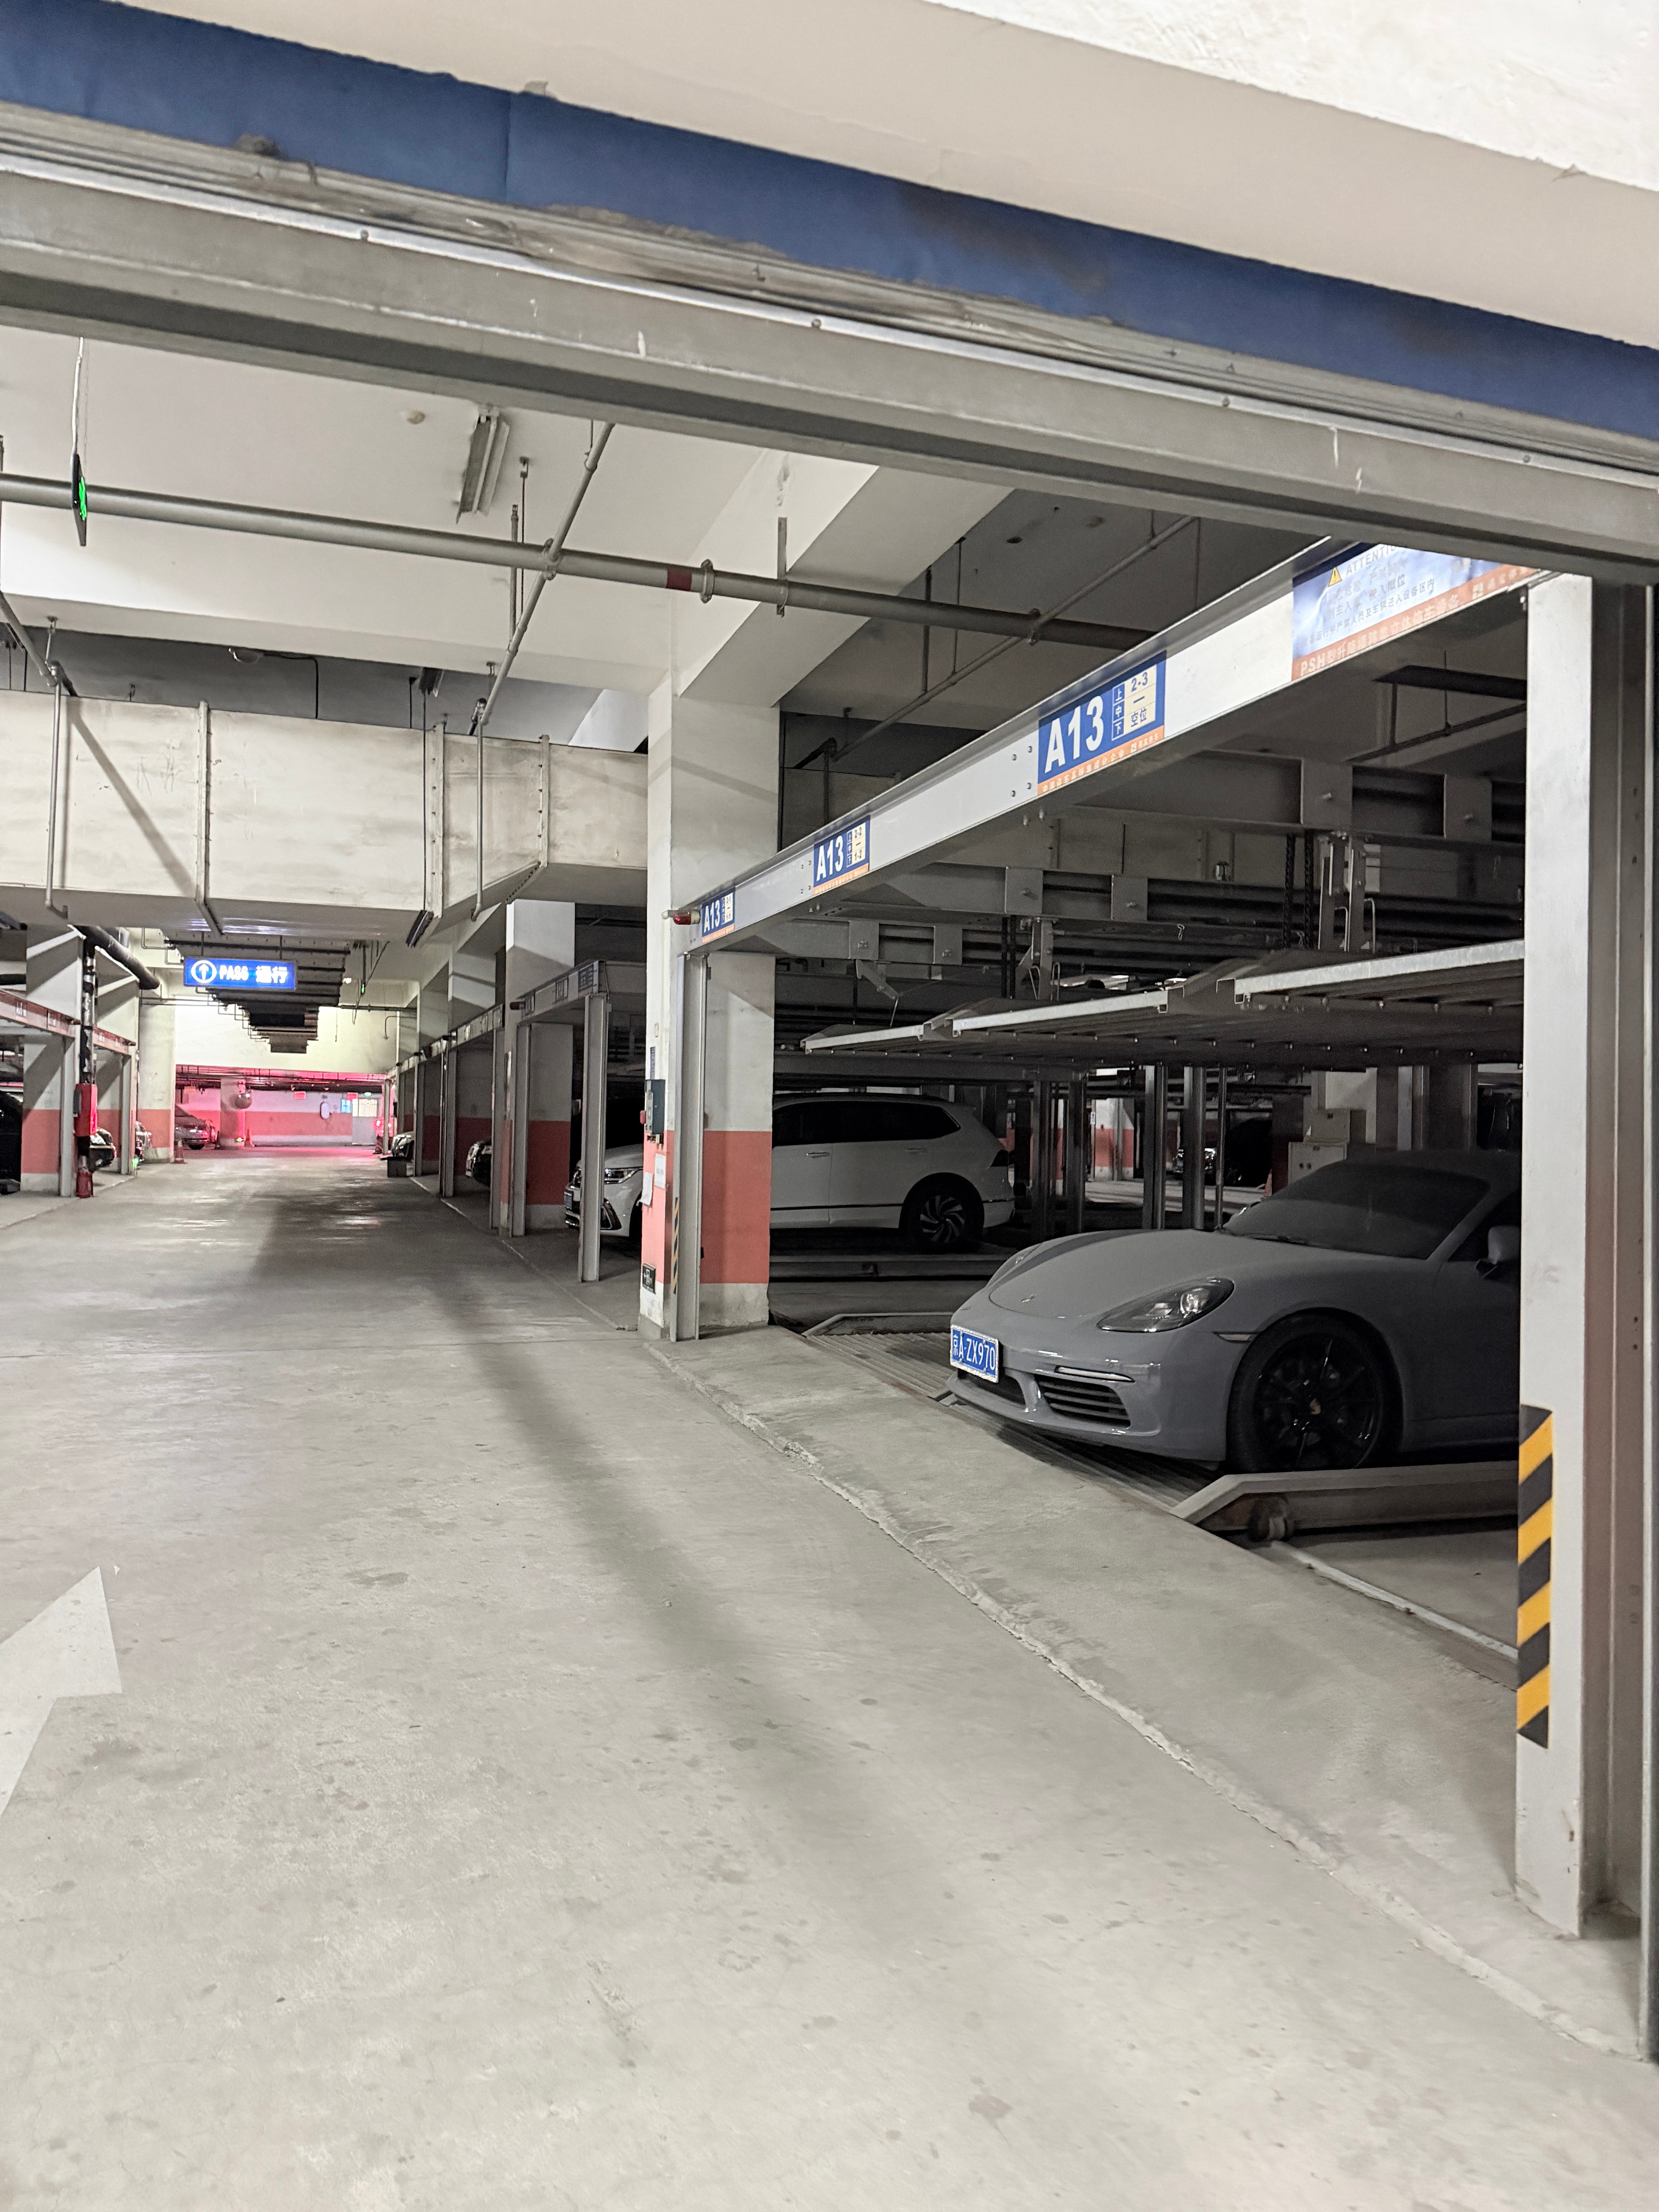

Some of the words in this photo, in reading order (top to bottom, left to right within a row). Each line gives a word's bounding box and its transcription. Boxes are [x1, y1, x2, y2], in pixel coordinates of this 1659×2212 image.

[1115, 688, 1122, 702] 上
[1115, 705, 1122, 718] 中
[1131, 707, 1147, 727] 空位
[1044, 696, 1104, 774] A13
[1115, 721, 1122, 735] 下
[816, 835, 843, 881] A13
[704, 900, 720, 933] A13
[219, 965, 249, 981] PASS
[255, 965, 288, 984] 通行
